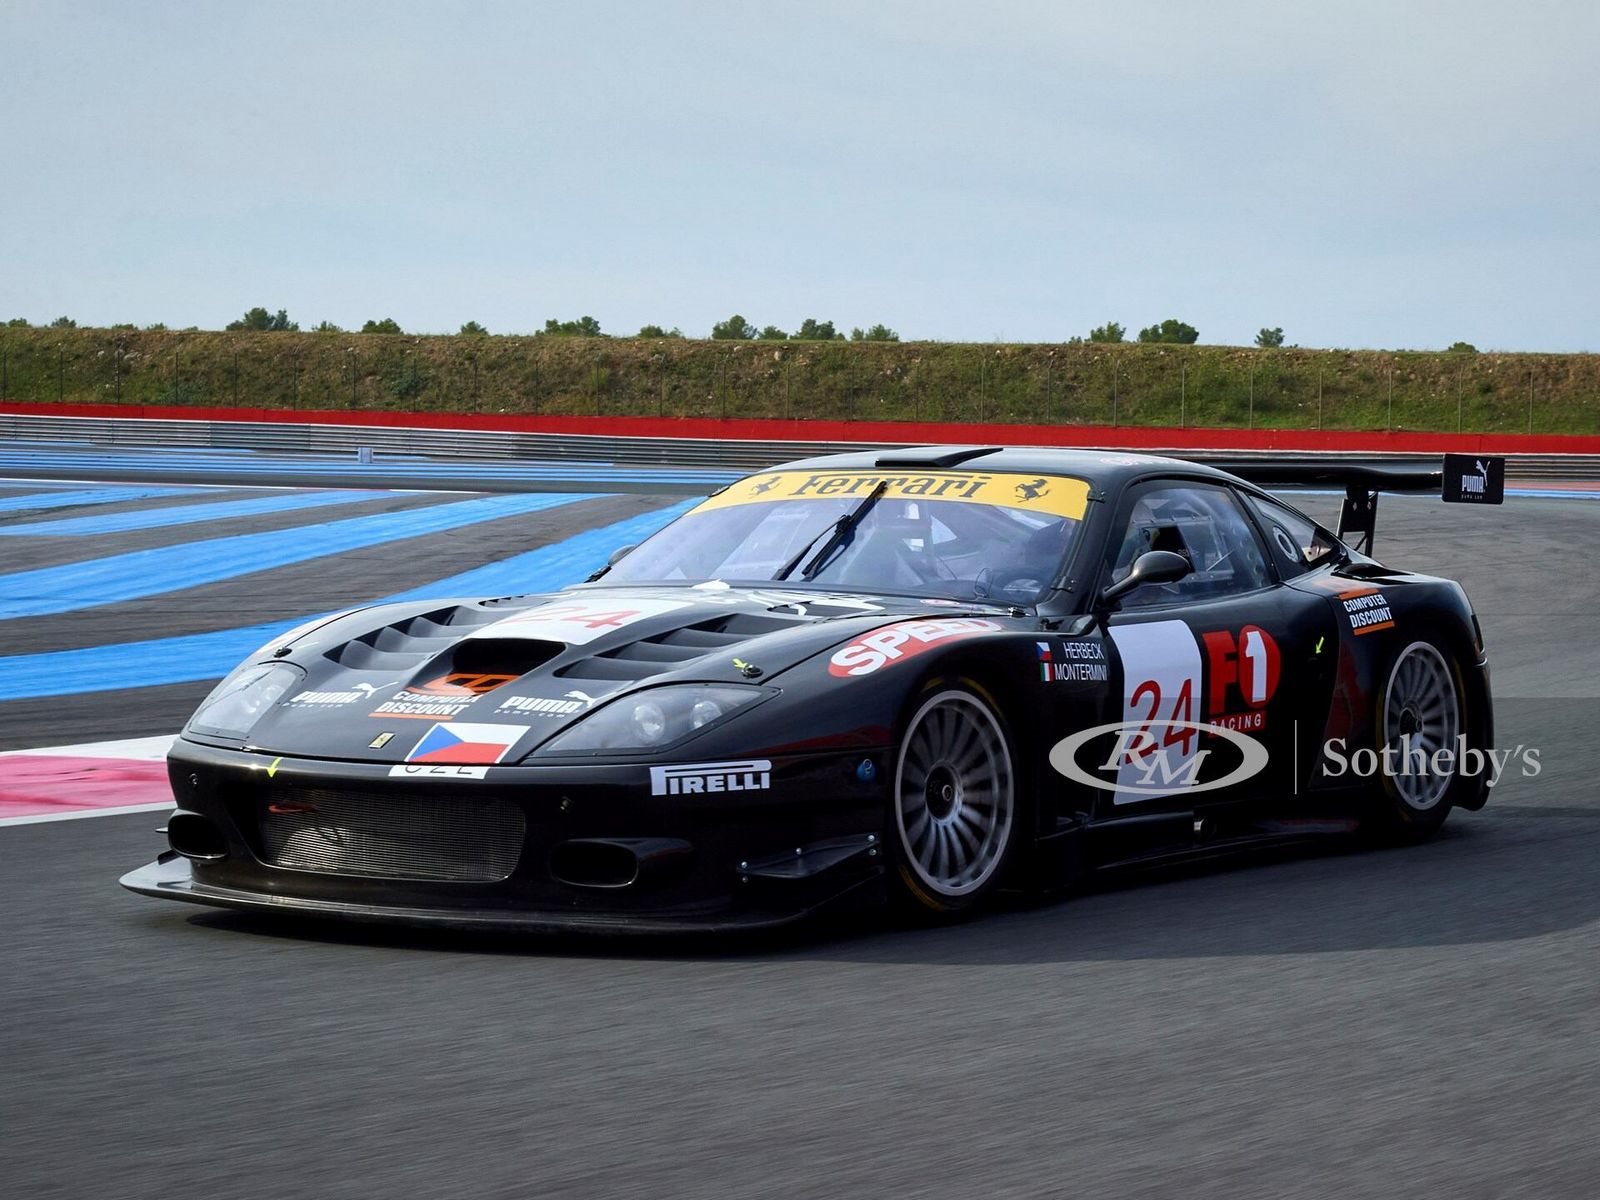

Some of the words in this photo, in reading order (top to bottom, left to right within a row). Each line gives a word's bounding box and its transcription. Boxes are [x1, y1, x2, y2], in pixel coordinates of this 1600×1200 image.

[1343, 594, 1387, 613] COMPUTER
[499, 606, 641, 629] 24
[1349, 607, 1392, 628] DISCOUNT
[1063, 642, 1104, 659] HERBECK
[1054, 663, 1107, 681] MONTERMINI
[374, 702, 470, 715] DISCOUNT
[499, 696, 583, 714] PUMA
[1126, 678, 1197, 764] 24
[649, 759, 772, 796] PIRELLI
